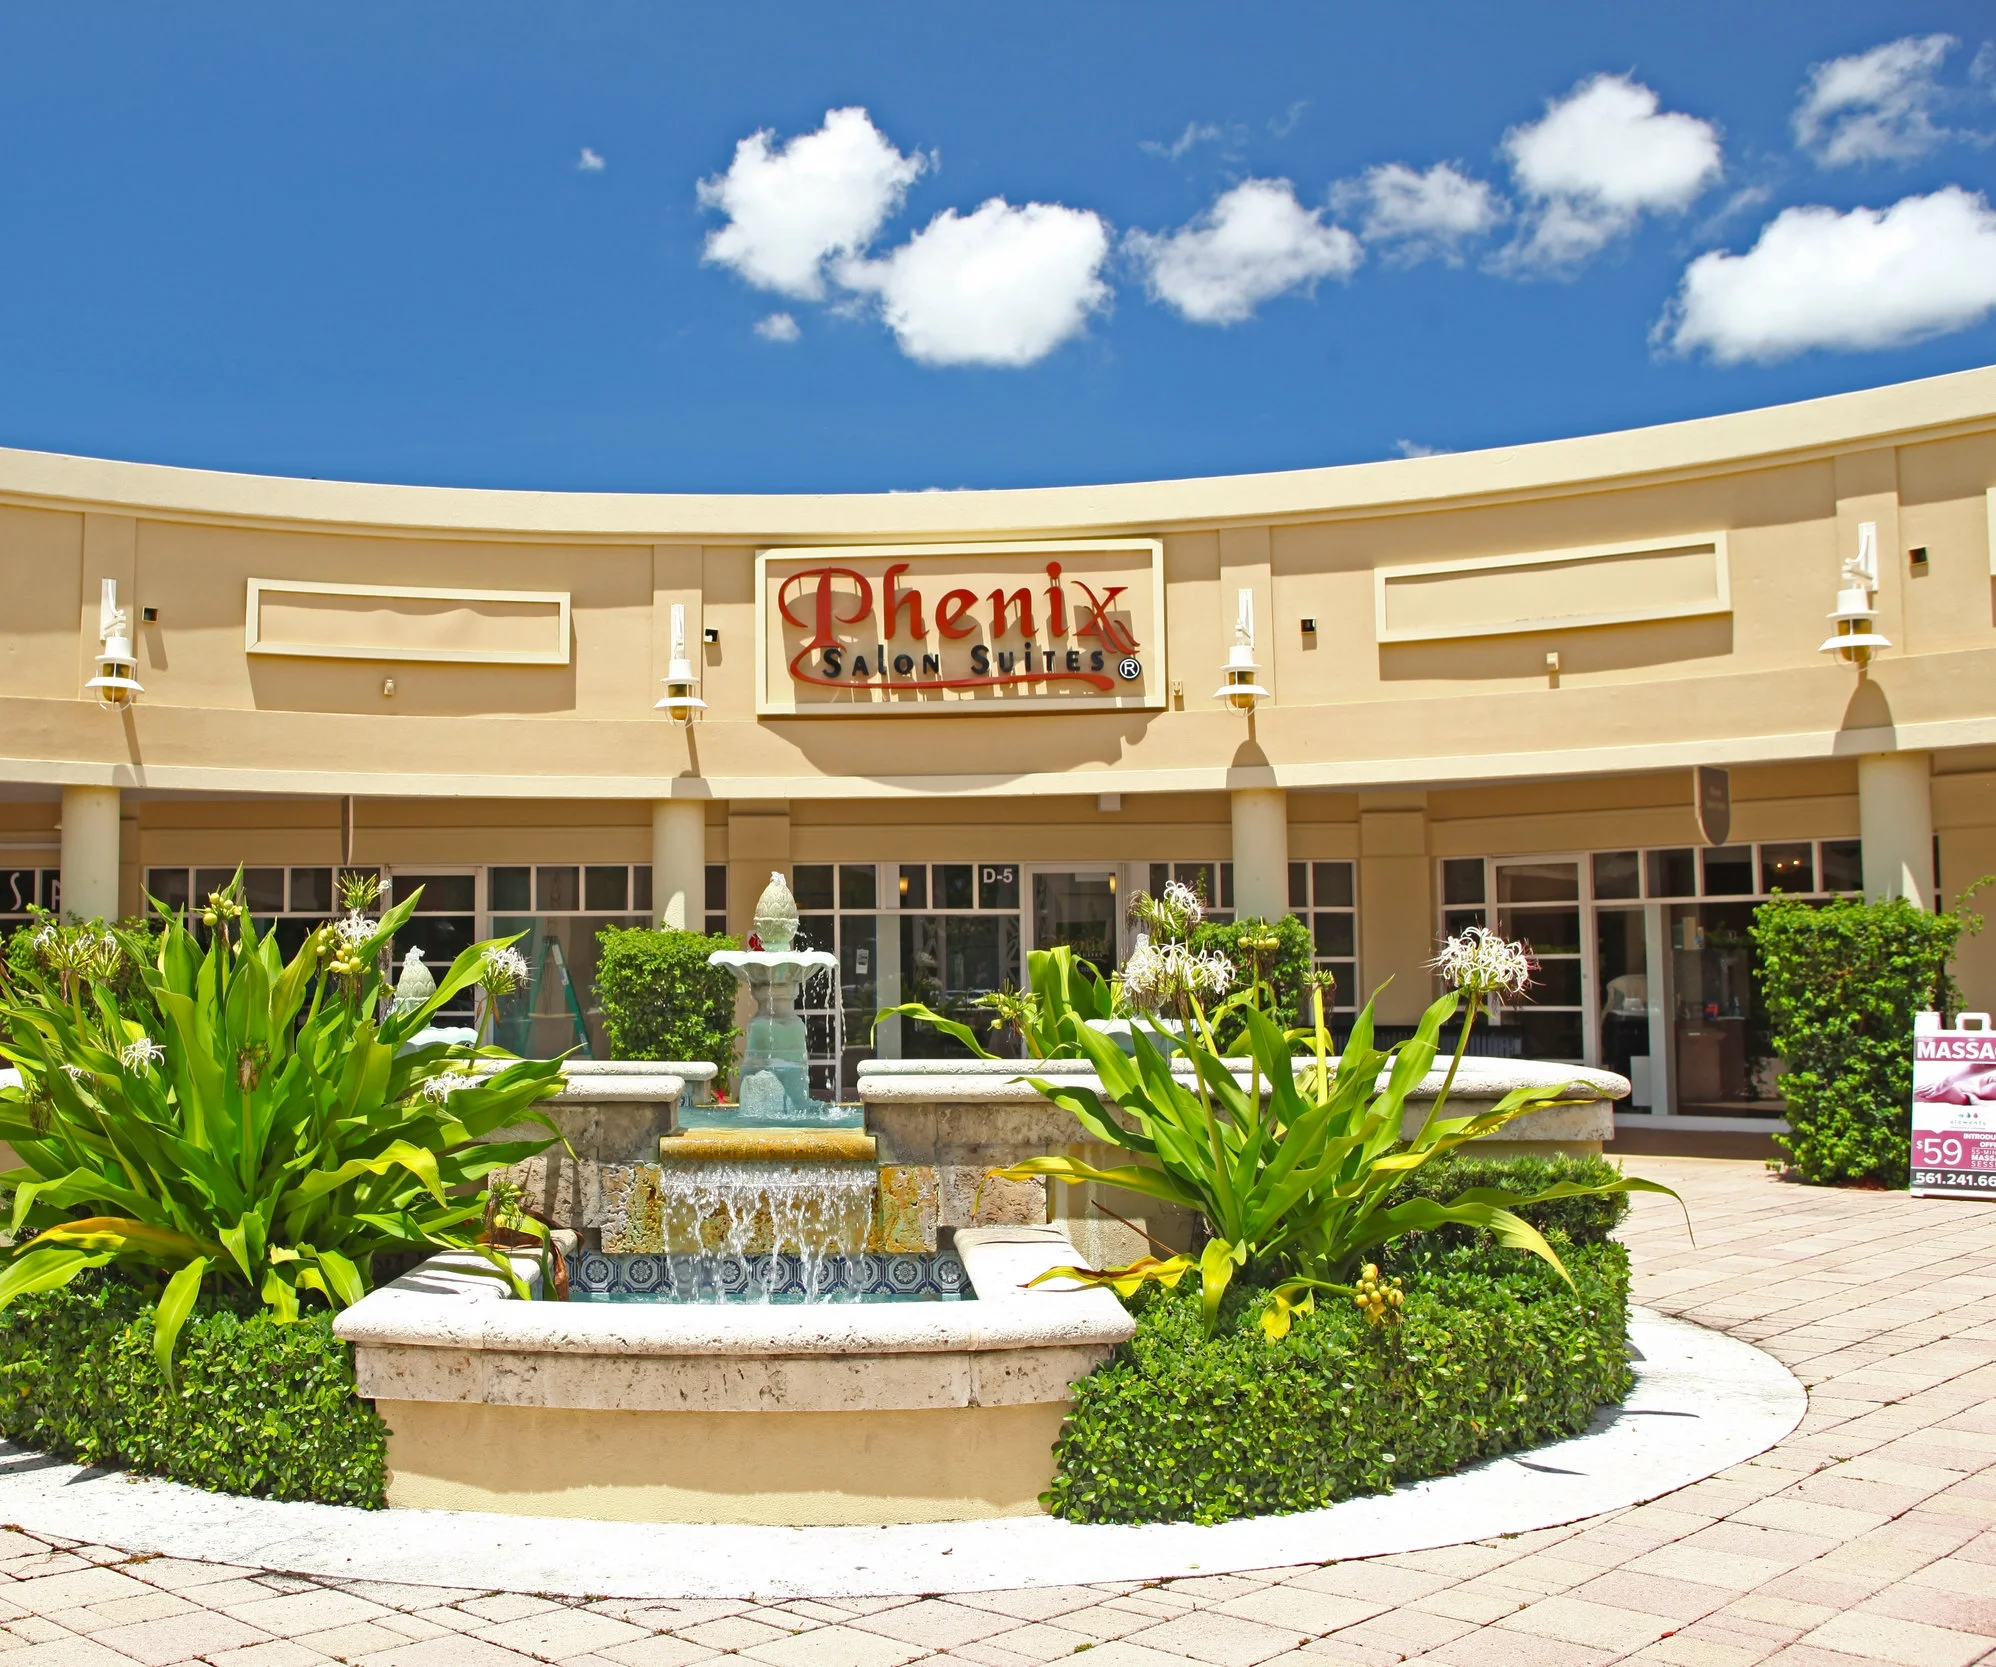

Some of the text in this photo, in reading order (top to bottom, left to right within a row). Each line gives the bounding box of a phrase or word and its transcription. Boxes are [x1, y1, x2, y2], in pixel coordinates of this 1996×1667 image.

[778, 561, 1141, 656] Phenix
[983, 868, 1013, 883] D-5
[1917, 1041, 1996, 1060] MASSA
[1971, 1154, 1996, 1162] MASS
